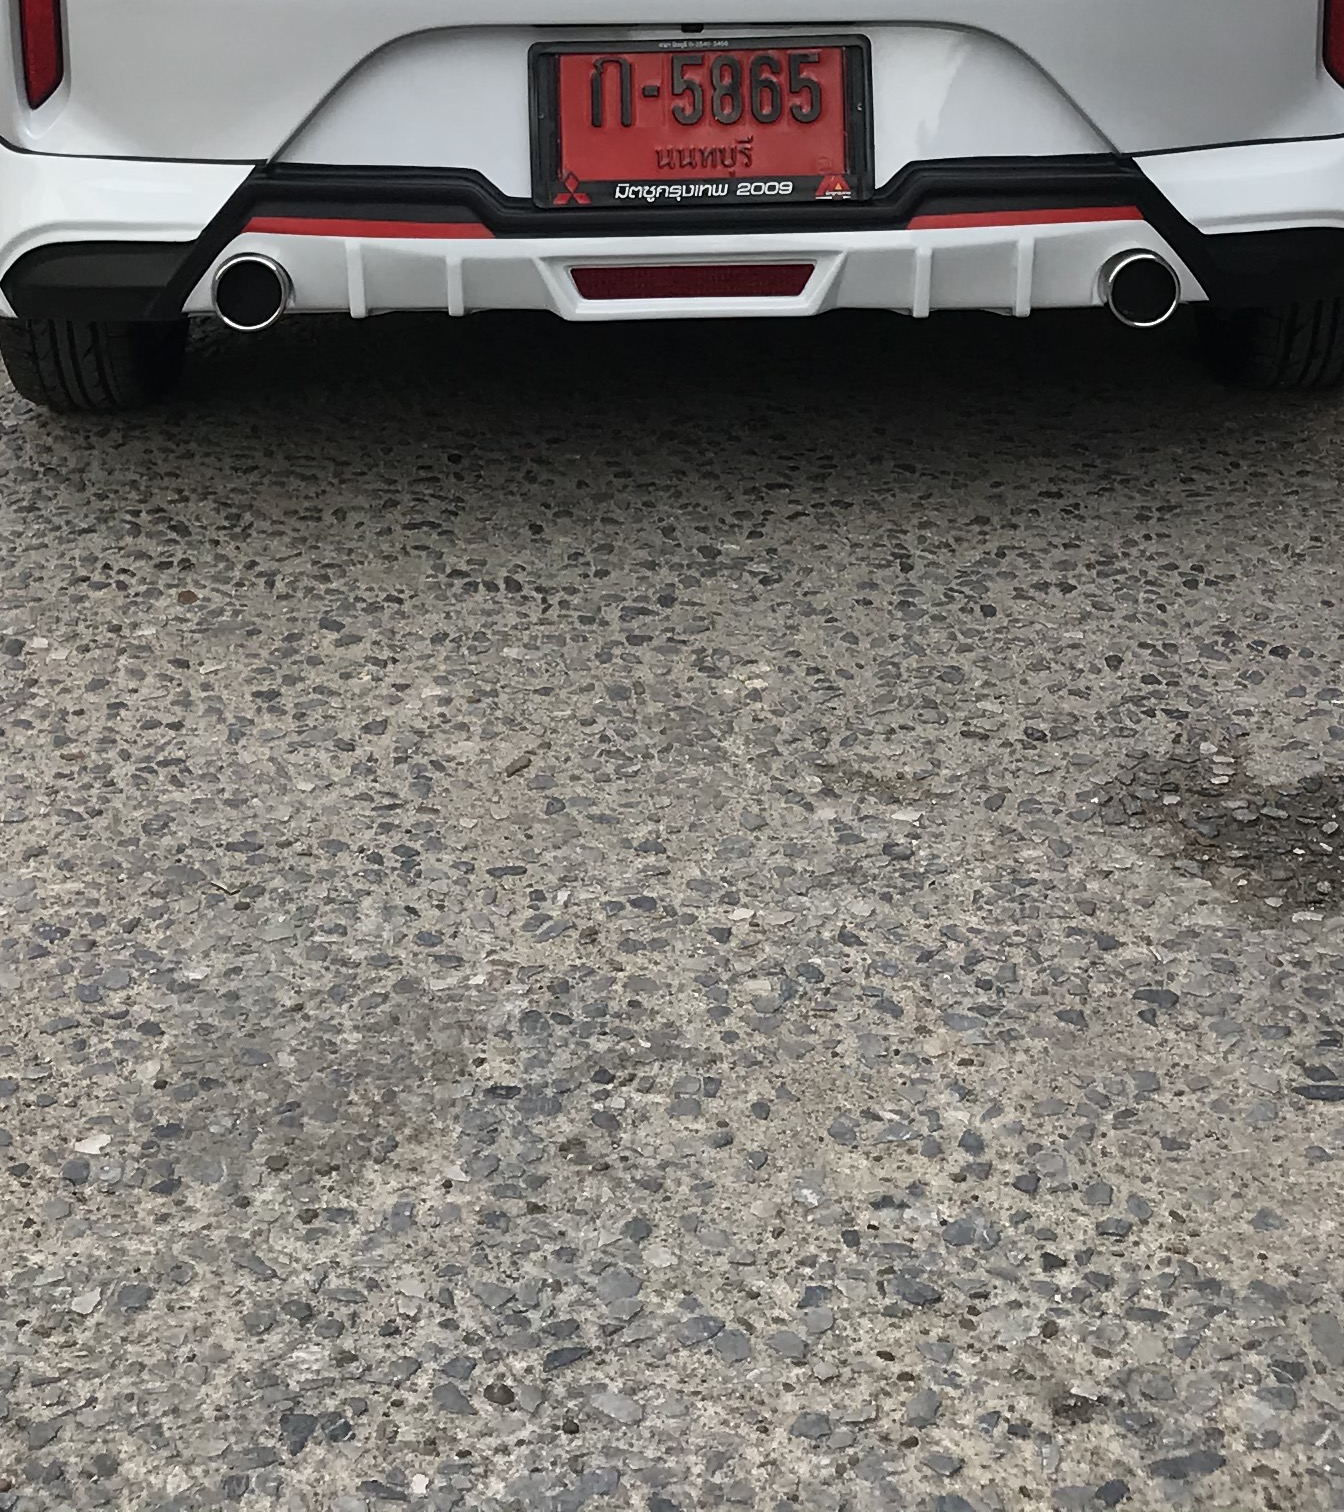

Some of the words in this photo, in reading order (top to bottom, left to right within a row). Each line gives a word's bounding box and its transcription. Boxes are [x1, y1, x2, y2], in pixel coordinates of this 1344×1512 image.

[590, 52, 822, 127] ก-5865
[654, 136, 753, 176] นนทบุรี
[737, 181, 793, 196] 2009
